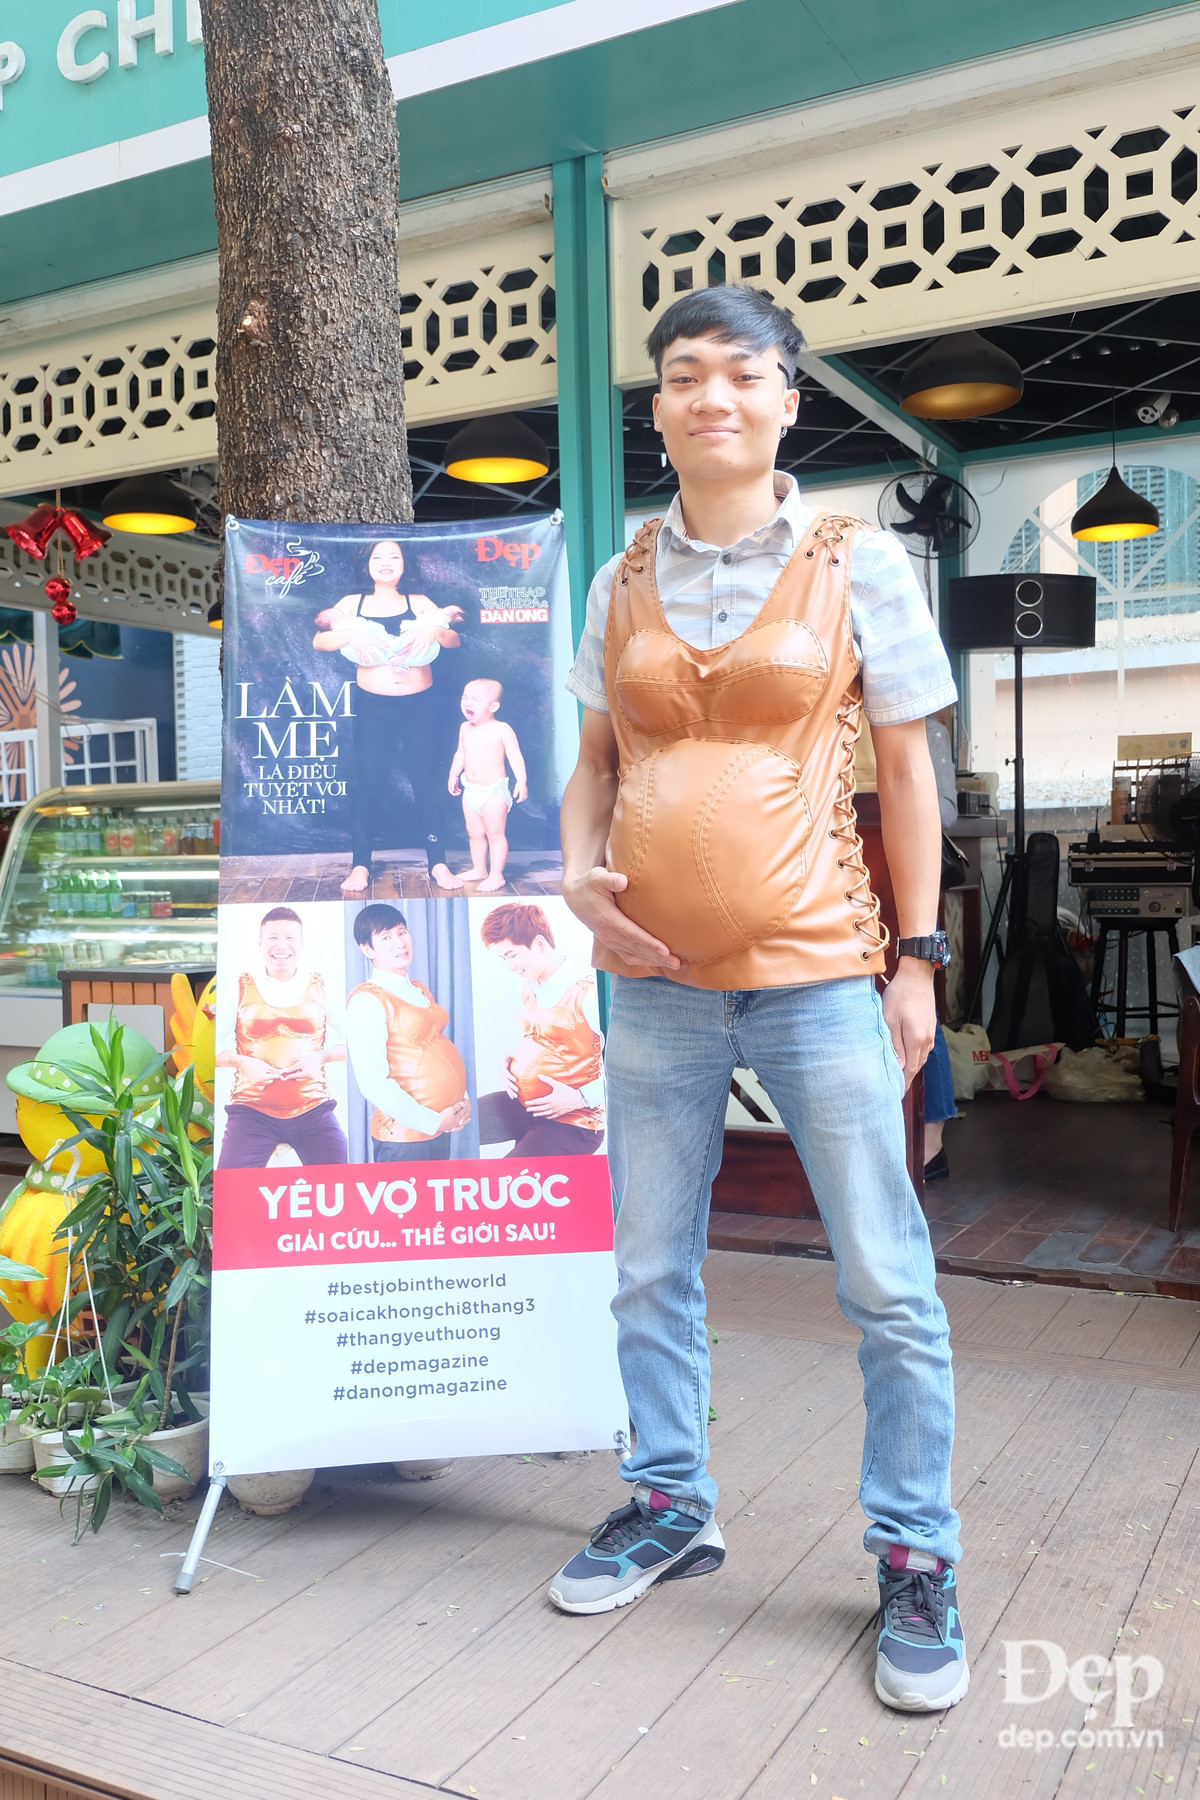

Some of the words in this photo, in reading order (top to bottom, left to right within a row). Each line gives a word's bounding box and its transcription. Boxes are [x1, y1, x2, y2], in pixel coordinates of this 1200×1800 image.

[474, 536, 541, 569] Đẹp
[265, 561, 308, 599] café
[235, 676, 358, 719] LÀM
[252, 721, 339, 761] MẸ
[259, 763, 285, 780] LÀ
[244, 780, 312, 798] TUYỆT
[316, 779, 348, 796] VỜI
[262, 797, 326, 815] NHẤT!
[258, 1177, 344, 1220] YÊU
[355, 1177, 417, 1219] VỢ
[427, 1168, 571, 1212] TRƯỚC
[277, 1228, 325, 1253] GIẢI
[330, 1227, 397, 1250] CỨU...
[401, 1221, 446, 1247] THẾ
[451, 1221, 500, 1245] GIỚI
[505, 1222, 556, 1242] SAU!
[327, 1273, 507, 1296] #bestjobintheworld
[304, 1298, 536, 1324] #soaicakhongchi8thang3
[336, 1326, 501, 1347] #thangyeuthuong
[351, 1354, 489, 1375] #depmagazine
[333, 1377, 507, 1401] #danongmagazine
